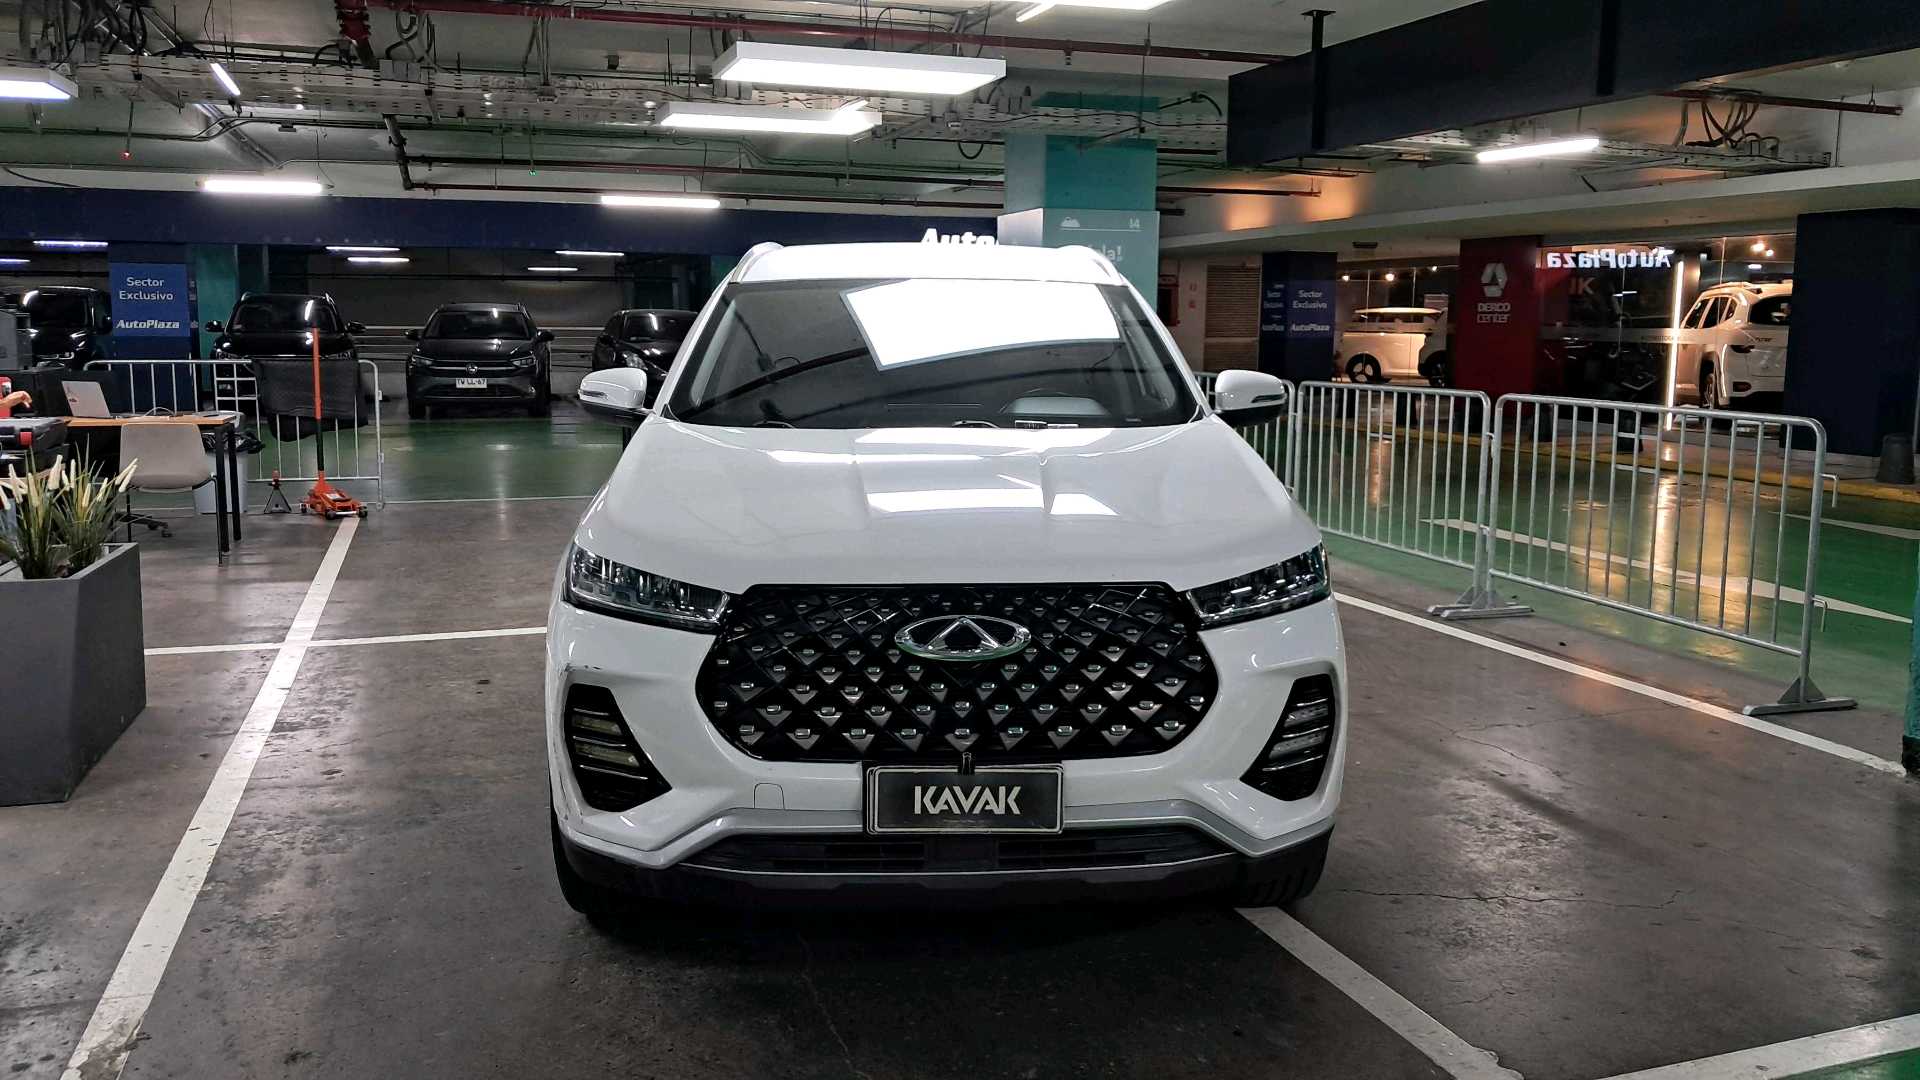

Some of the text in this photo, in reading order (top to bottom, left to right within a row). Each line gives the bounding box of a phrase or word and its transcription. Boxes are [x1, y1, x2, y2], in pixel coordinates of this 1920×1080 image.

[126, 277, 165, 287] Sector
[119, 290, 174, 300] Exclusivo
[1477, 302, 1511, 312] DERCO
[116, 319, 180, 329] AutoPlaza
[914, 785, 1022, 815] KAVAK
